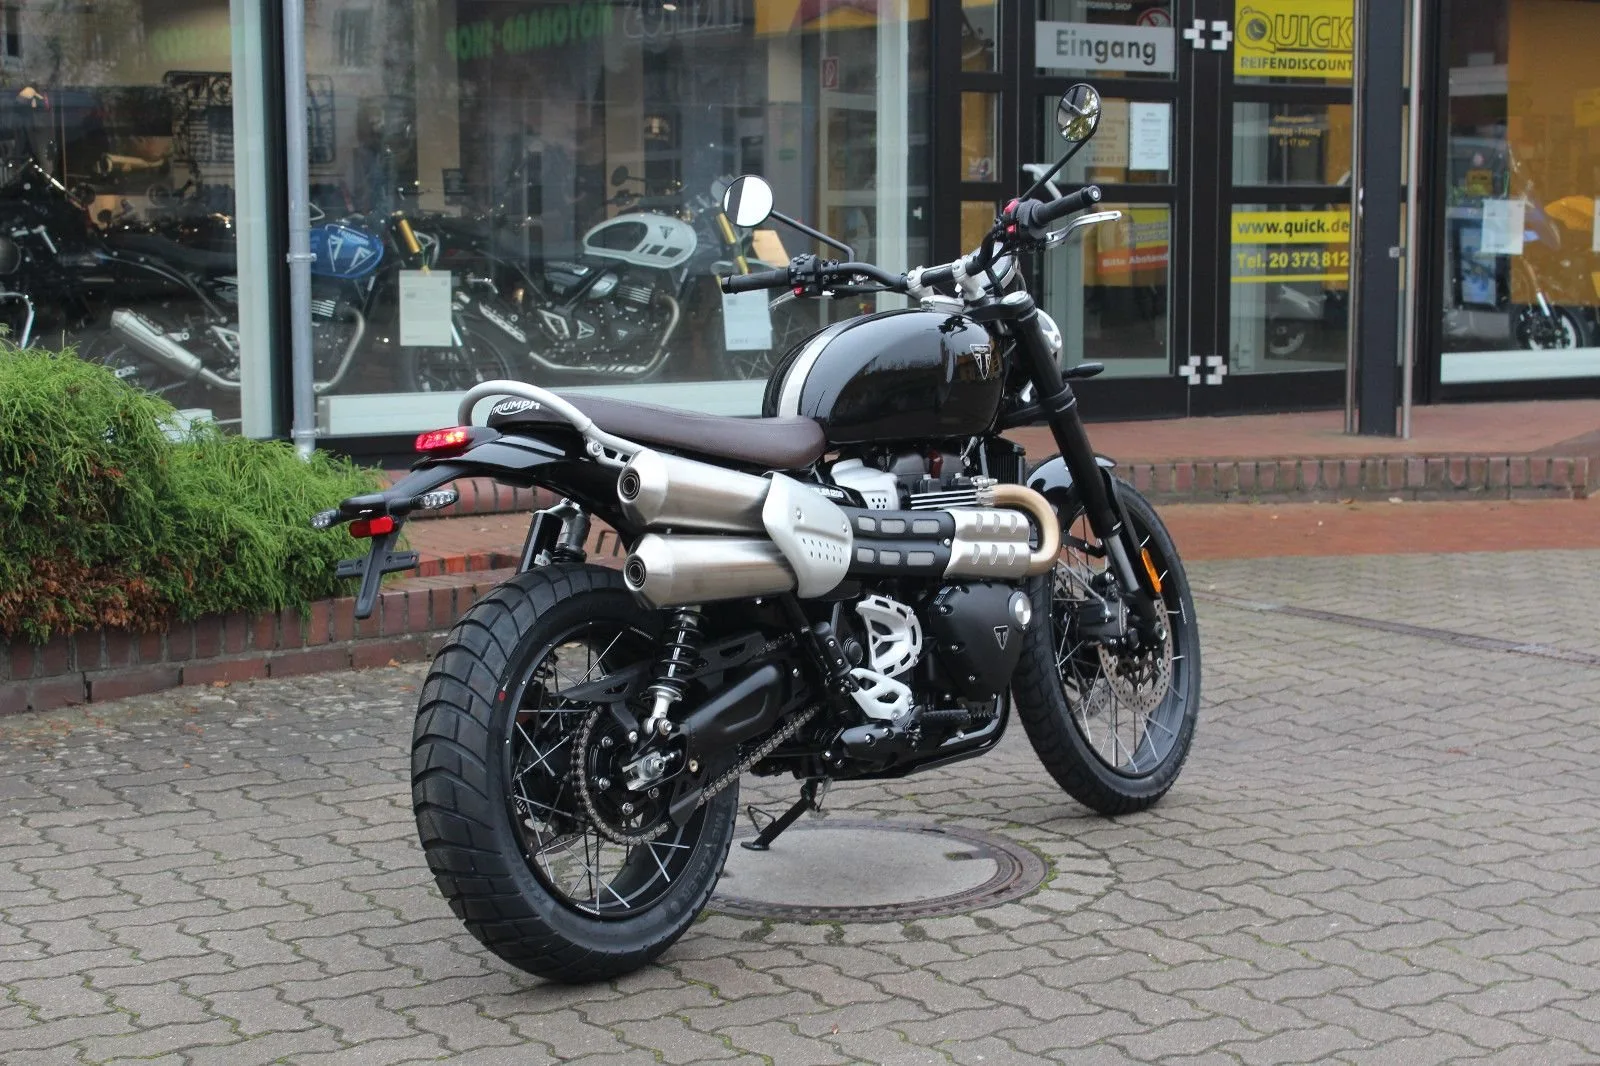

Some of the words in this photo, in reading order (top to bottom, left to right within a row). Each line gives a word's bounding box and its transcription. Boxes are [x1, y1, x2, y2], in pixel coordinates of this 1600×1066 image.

[1237, 5, 1353, 53] QUICK
[1056, 29, 1156, 65] Eingang
[1241, 56, 1353, 71] REIFENDISCOUNT
[1238, 219, 1349, 237] www.quick.de
[1237, 253, 1266, 268] Tel.
[1269, 252, 1288, 268] 20
[1291, 251, 1319, 268] 373
[1322, 251, 1349, 267] 812
[491, 400, 540, 416] TRIUMPH
